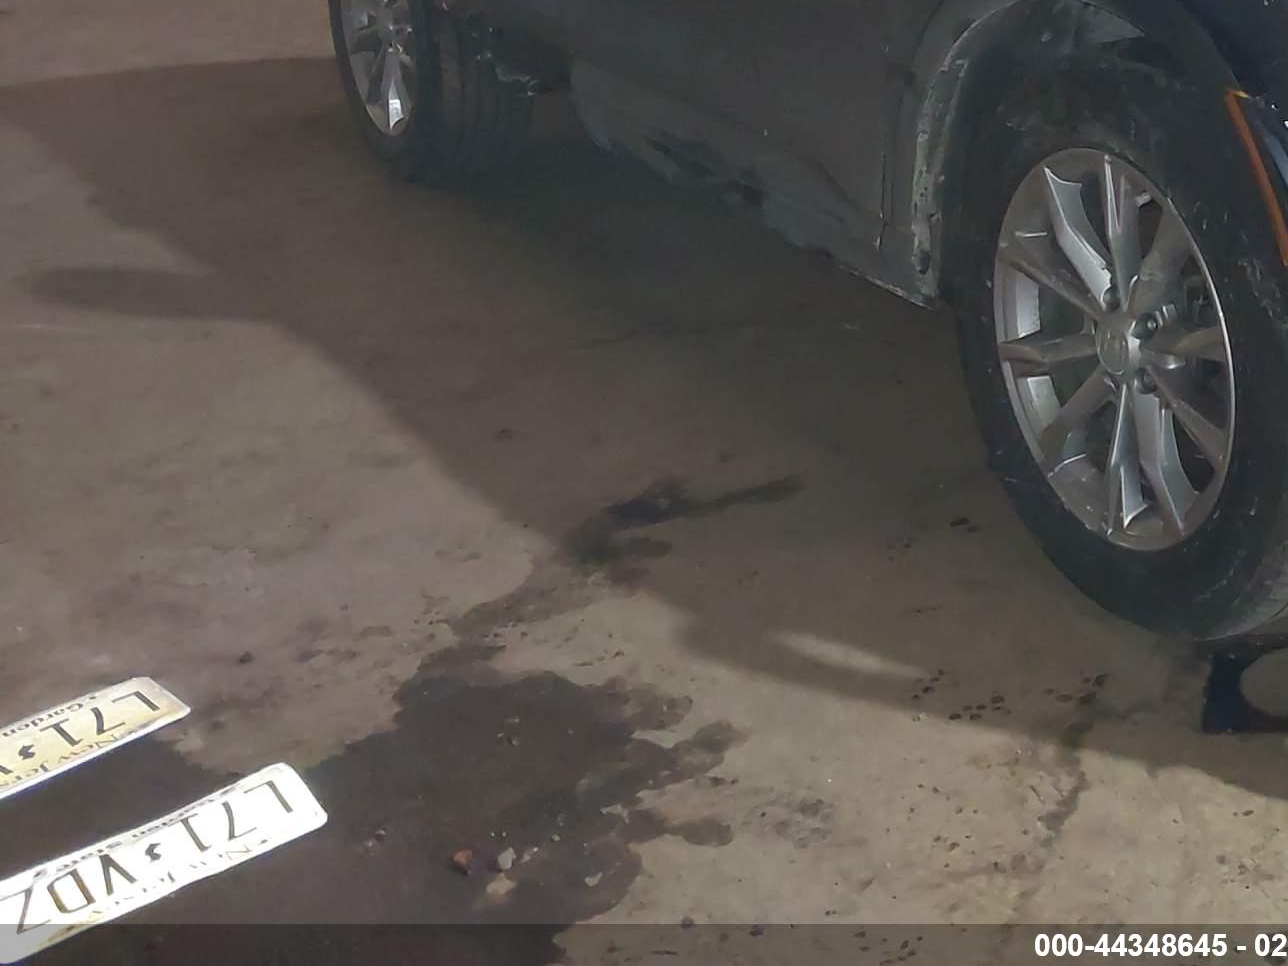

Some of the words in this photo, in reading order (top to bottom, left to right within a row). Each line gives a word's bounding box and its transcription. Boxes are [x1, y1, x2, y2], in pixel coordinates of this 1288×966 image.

[2, 702, 84, 737] Garden
[40, 690, 160, 747] L71
[58, 733, 121, 761] New
[167, 780, 294, 853] L71
[0, 854, 138, 935] VDZ
